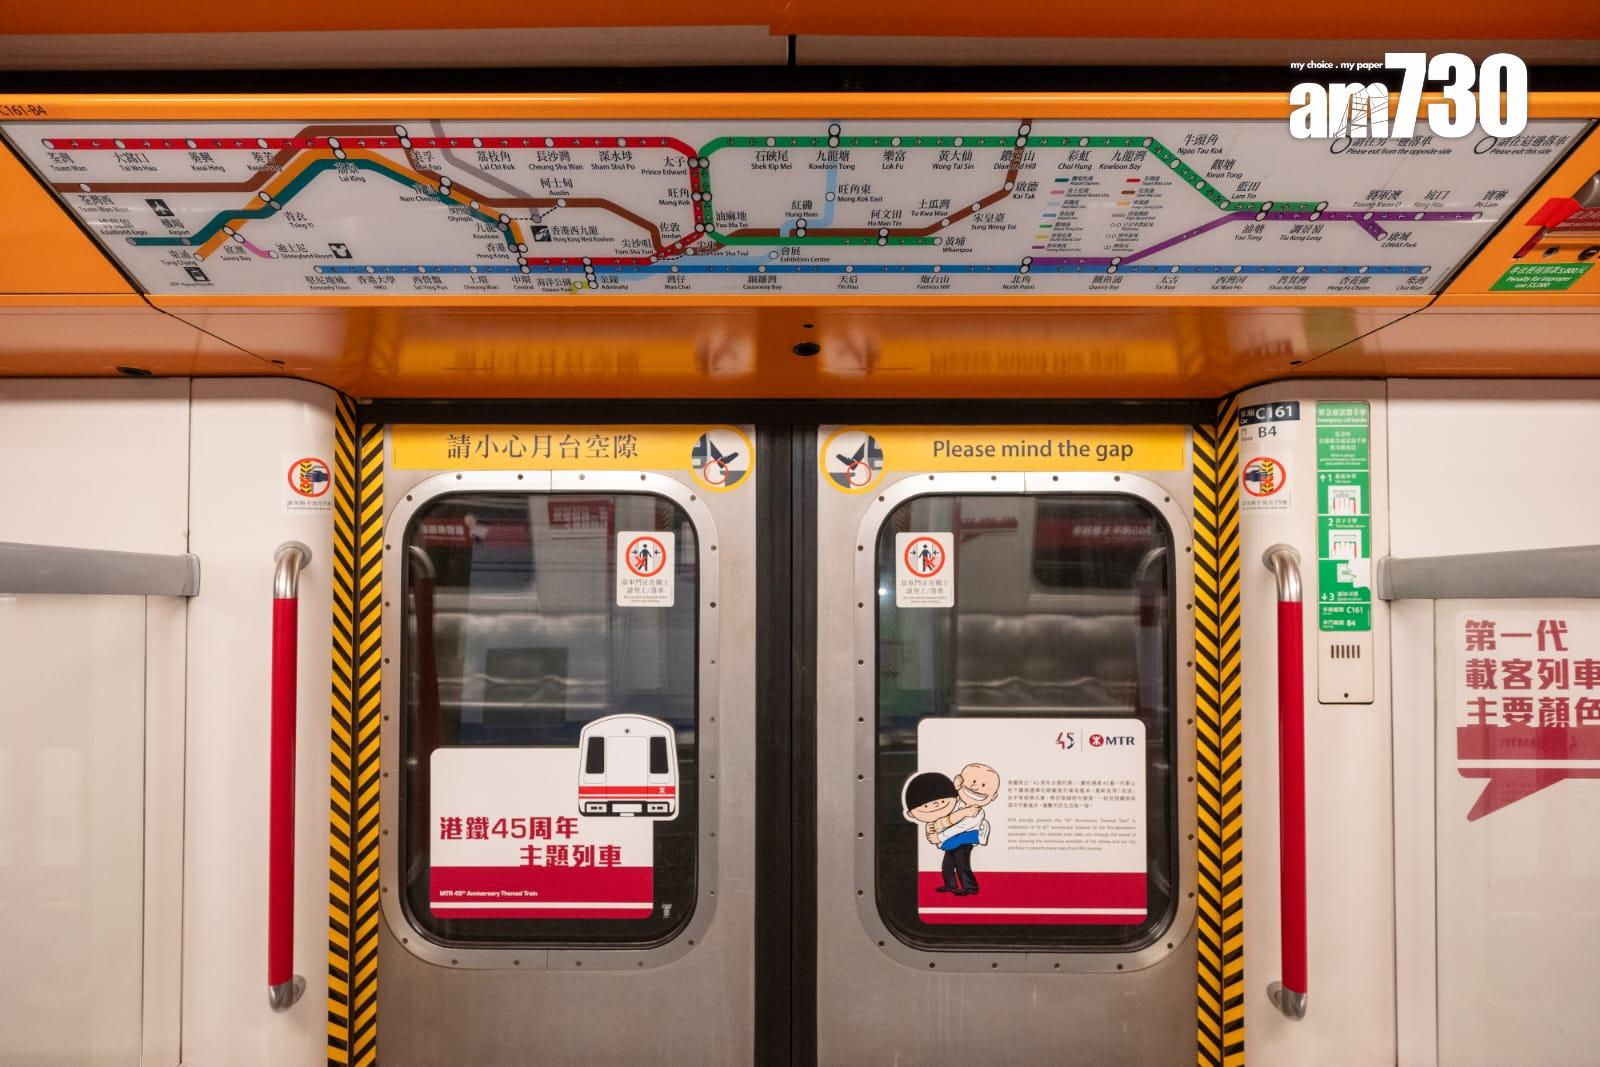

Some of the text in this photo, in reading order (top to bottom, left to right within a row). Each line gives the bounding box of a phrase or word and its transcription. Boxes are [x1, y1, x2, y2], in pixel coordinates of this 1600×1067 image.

[1185, 134, 1218, 145] 牛頭角
[478, 151, 511, 162] 荔枝角
[537, 151, 571, 162] 長沙灣
[664, 156, 686, 167] 太子
[755, 151, 788, 162] 石硤尾
[816, 151, 850, 162] 九龍塘
[883, 151, 905, 161] 樂富
[938, 151, 972, 161] 黃大仙
[1068, 151, 1090, 161] 彩虹
[1112, 151, 1146, 162] 九龍灣
[1211, 159, 1236, 170] 觀塘
[839, 184, 871, 194] 旺角東
[1237, 182, 1260, 192] 藍田
[668, 188, 689, 198] 旺角
[920, 200, 950, 209] 土瓜灣
[716, 212, 747, 221] 油麻地
[871, 210, 902, 219] 何文田
[660, 223, 680, 232] 佐敦
[1256, 406, 1293, 420] C161
[1258, 426, 1277, 438] B4
[447, 433, 638, 460] 請小心月台空隙
[933, 439, 1134, 461] Please mind the gap
[1328, 518, 1334, 526] 2
[1328, 592, 1334, 600] 3
[1465, 620, 1568, 651] 第一代
[1466, 658, 1600, 690] 載客列車
[1466, 697, 1600, 728] 主要顏色
[1106, 737, 1135, 745] MTR
[440, 816, 578, 840] 港鐵45周年
[520, 845, 622, 867] 主題列車
